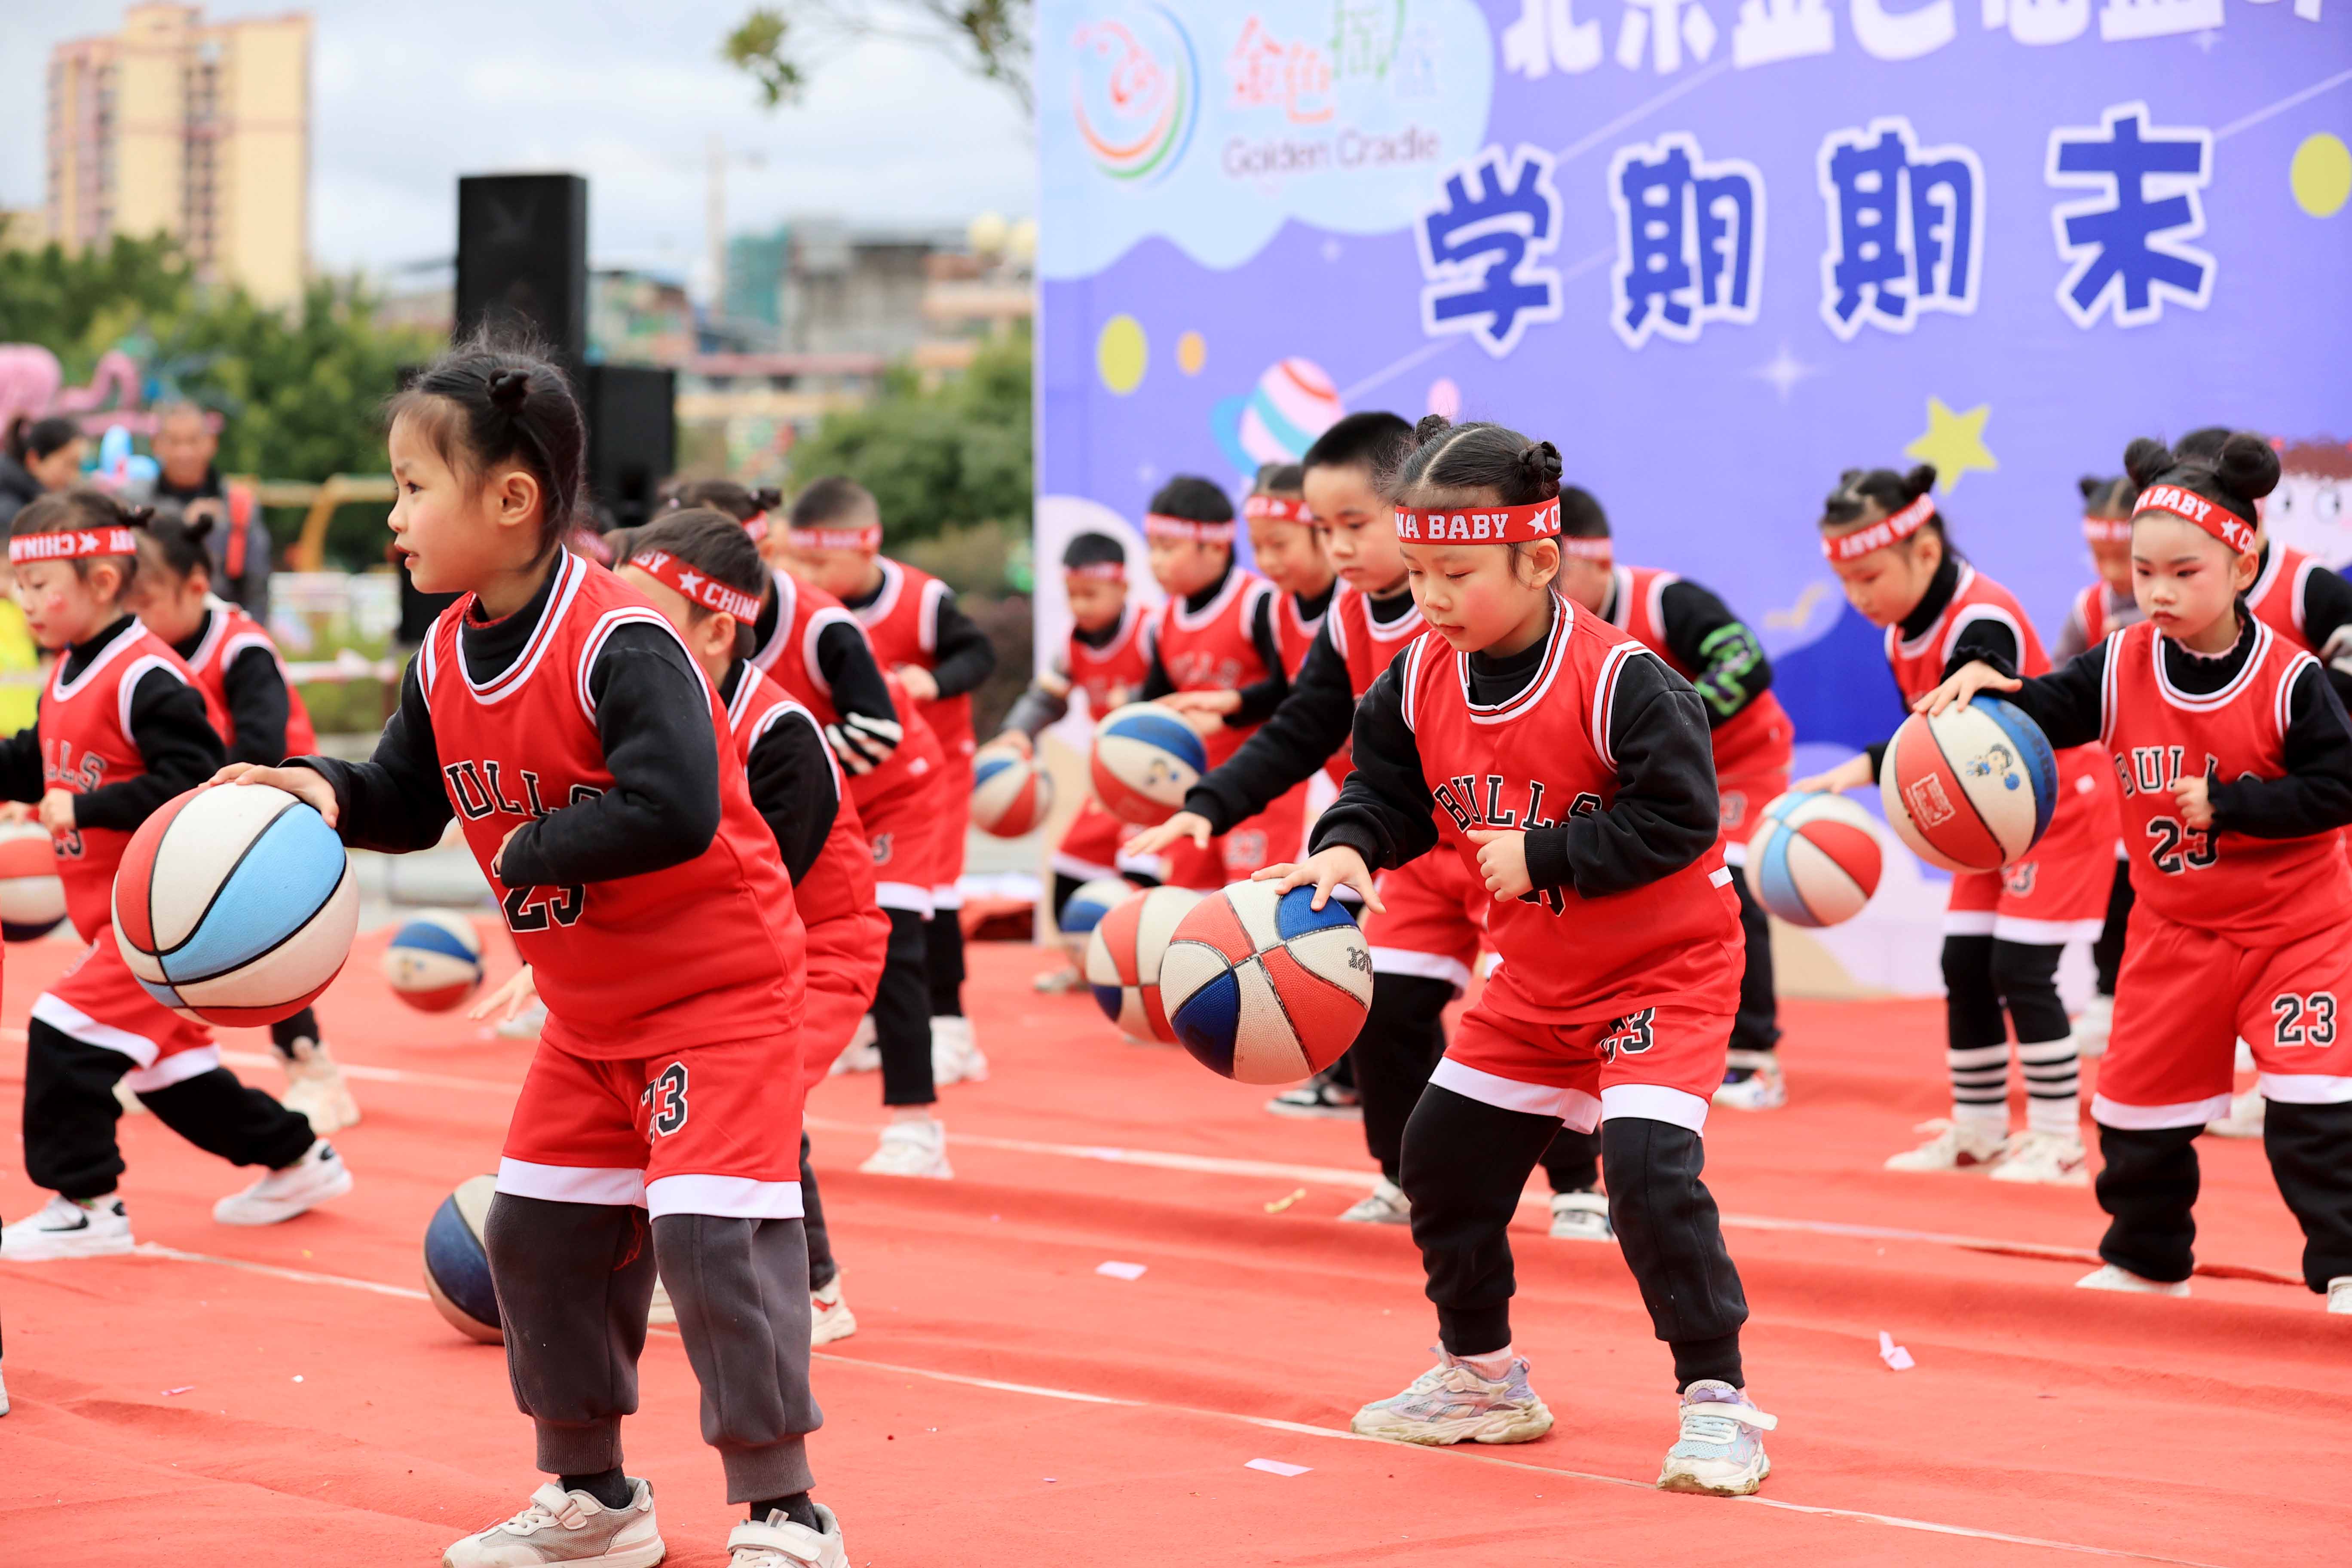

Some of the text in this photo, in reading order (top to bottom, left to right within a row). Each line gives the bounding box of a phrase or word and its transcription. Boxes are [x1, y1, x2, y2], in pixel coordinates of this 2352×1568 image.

[1222, 124, 1441, 177] Golden Cradle
[1416, 101, 2216, 358] 学期期末
[1428, 513, 1509, 540] BABY
[2150, 487, 2211, 523] BABY
[2146, 815, 2219, 876] 23
[2271, 991, 2337, 1048] 23
